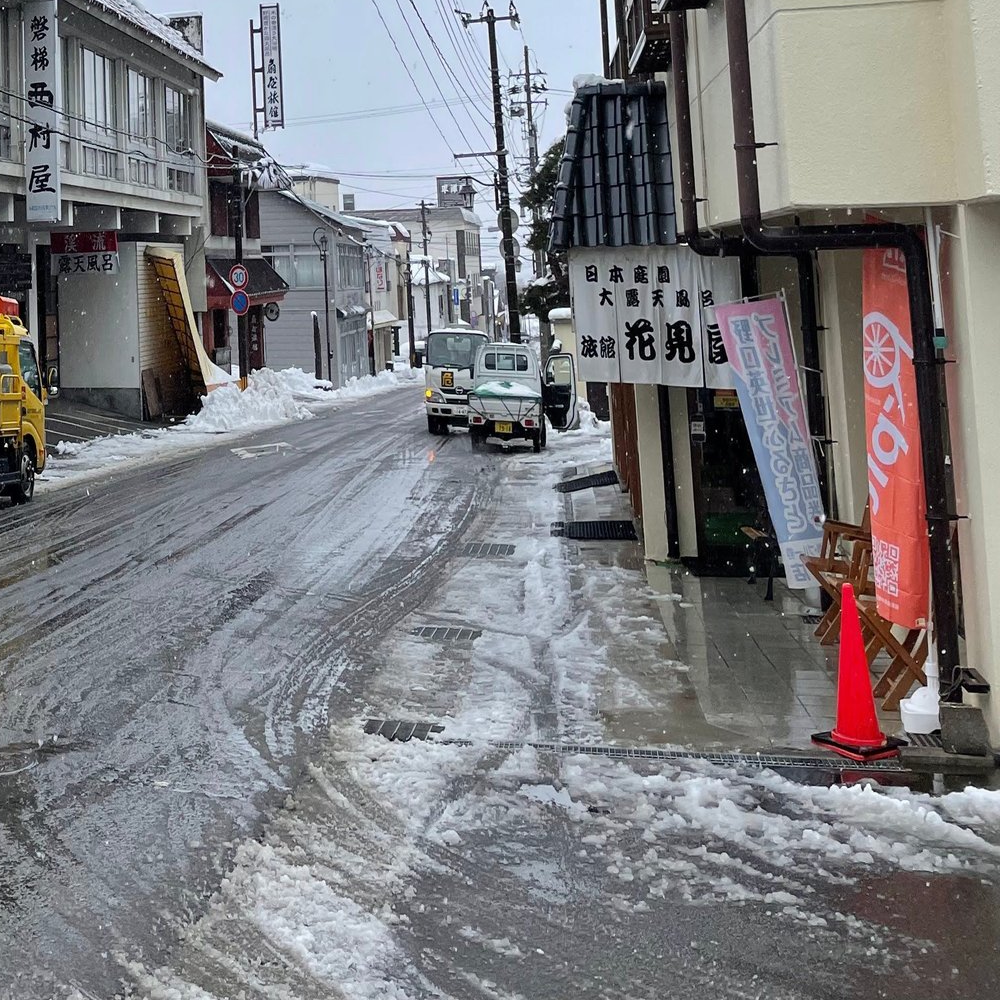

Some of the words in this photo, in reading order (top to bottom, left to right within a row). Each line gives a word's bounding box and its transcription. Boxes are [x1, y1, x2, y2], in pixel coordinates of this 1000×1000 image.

[27, 15, 56, 194] 磐梯西村屋
[58, 253, 114, 274] 露天風呂
[233, 272, 245, 283] 30
[599, 287, 715, 308] 大露天風呂
[581, 336, 616, 359] 旅館
[442, 372, 454, 387] 危
